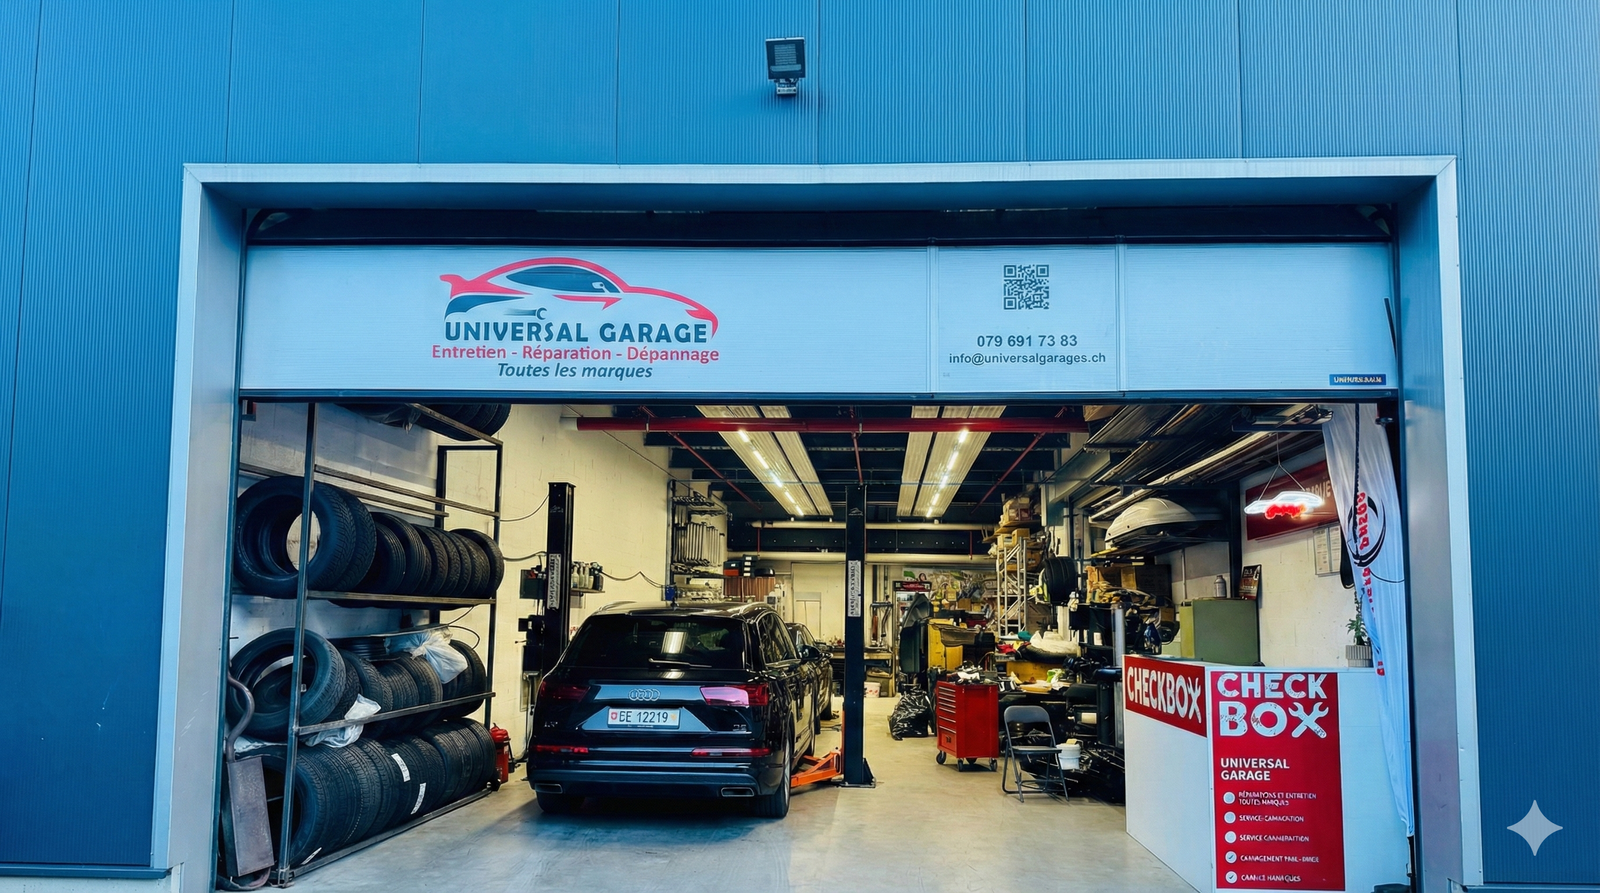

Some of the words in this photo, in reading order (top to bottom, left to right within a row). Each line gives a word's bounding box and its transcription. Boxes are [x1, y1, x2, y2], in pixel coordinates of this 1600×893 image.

[445, 321, 589, 342] UNIVERSAL
[600, 323, 707, 343] GARAGE
[977, 335, 1003, 347] 079
[1007, 335, 1032, 347] 691
[1038, 335, 1056, 347] 73
[1060, 334, 1078, 347] 83
[432, 345, 507, 360] Entretien
[522, 344, 611, 362] Réparation
[627, 346, 719, 364] Dépannage
[949, 352, 1106, 366] info@universalgarages.ch
[497, 363, 550, 378] Toutes
[555, 363, 577, 378] les
[582, 366, 653, 381] marques
[1217, 672, 1328, 699] CHECK
[1127, 666, 1202, 724] CHECKBOX
[637, 711, 669, 723] 12219
[1220, 757, 1290, 769] UNIVERSAL
[1221, 770, 1271, 781] GARAGE
